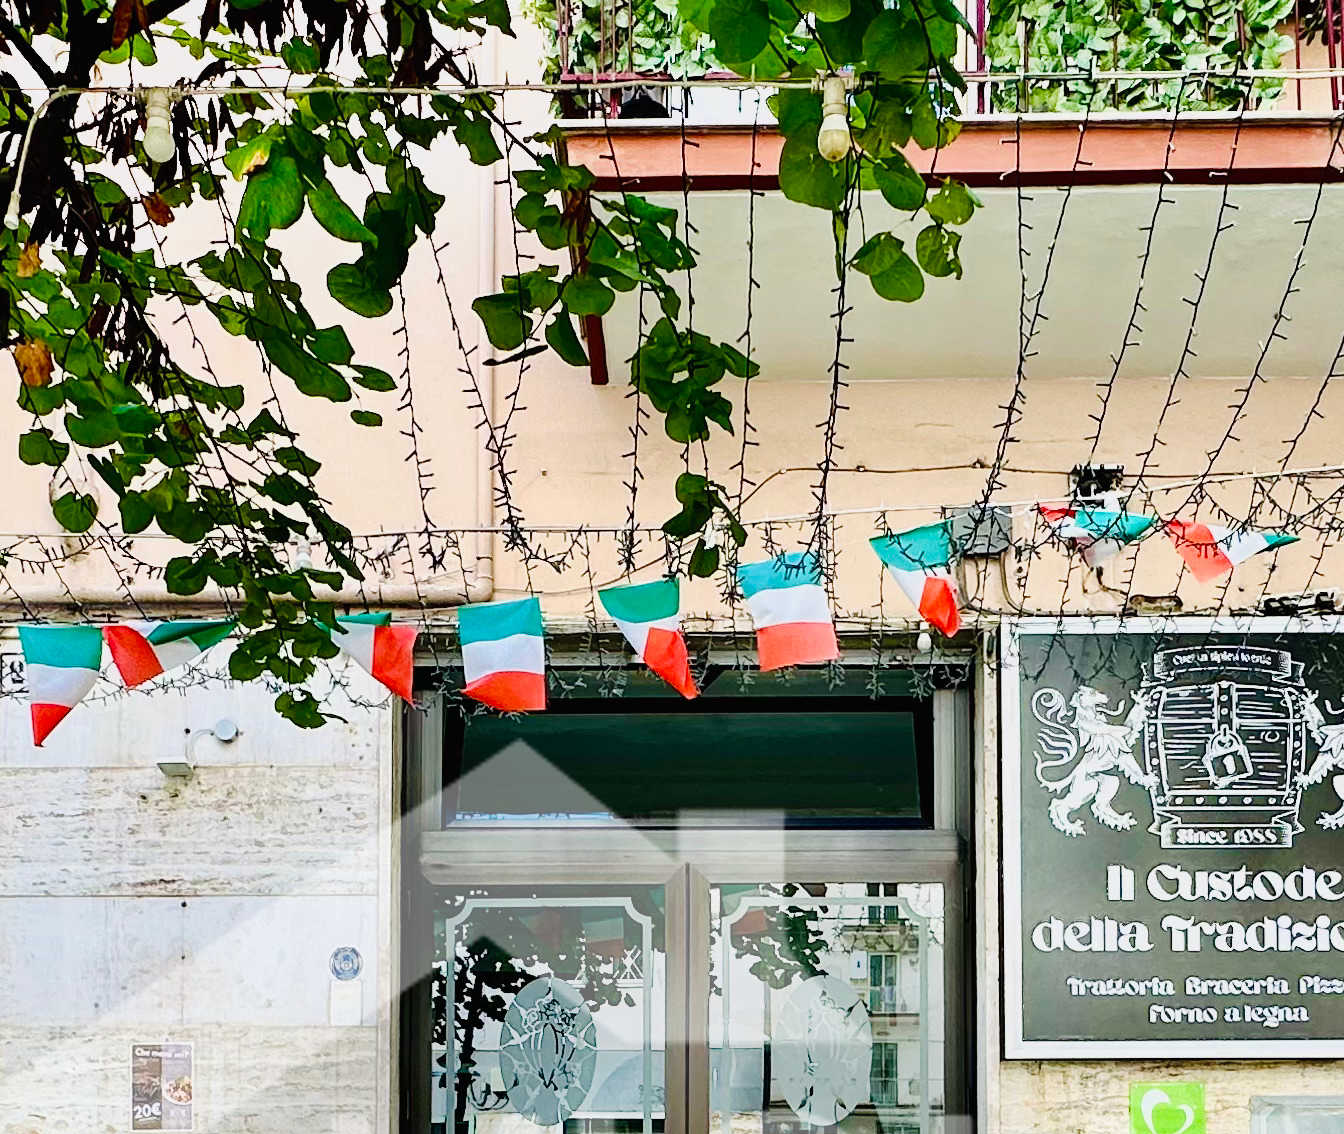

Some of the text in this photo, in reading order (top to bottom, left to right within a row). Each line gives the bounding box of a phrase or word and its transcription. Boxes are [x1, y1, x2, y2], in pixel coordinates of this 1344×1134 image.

[1175, 827, 1228, 844] Since
[1106, 864, 1136, 901] Il
[1032, 915, 1154, 953] della
[1067, 977, 1176, 996] Trattoria
[1185, 977, 1290, 996] Braceria
[1148, 1005, 1310, 1028] Forno a legna
[134, 1102, 162, 1118] 20€
